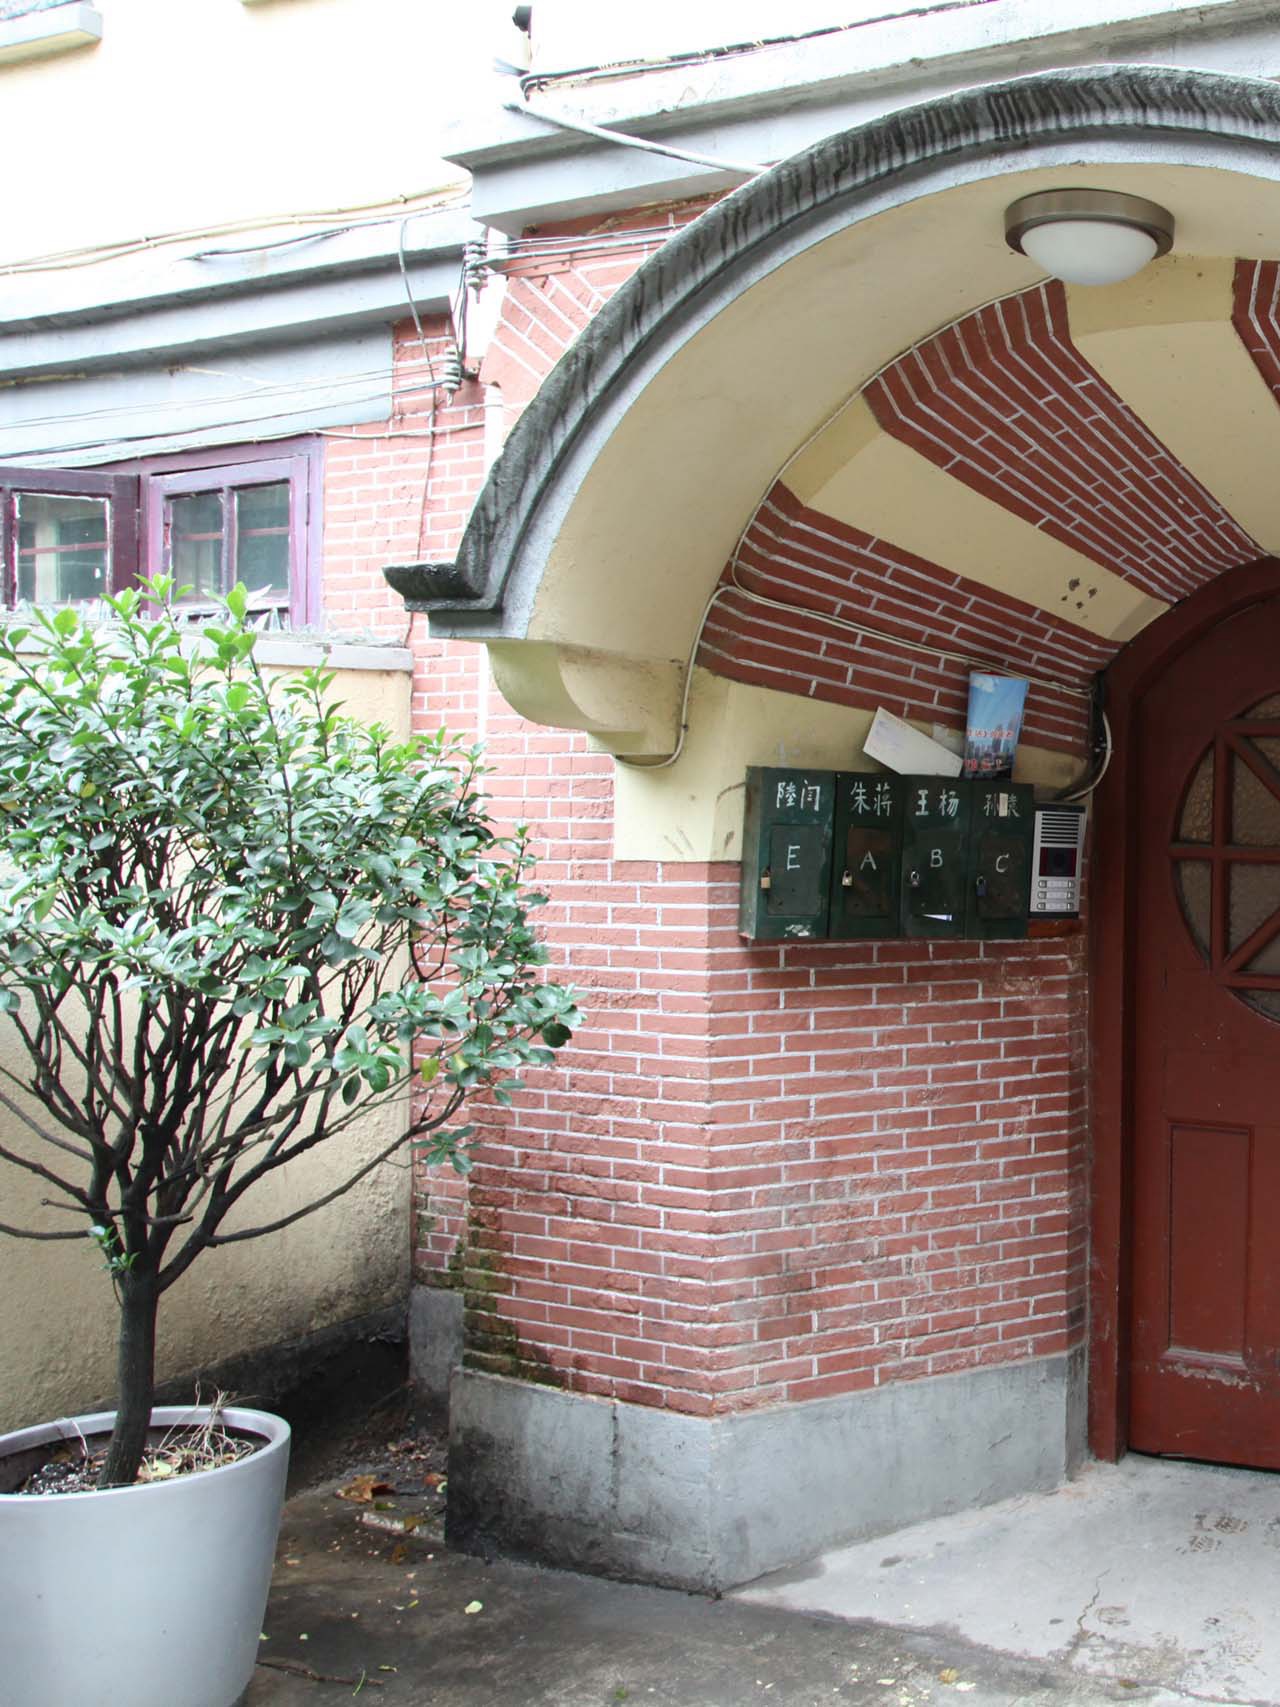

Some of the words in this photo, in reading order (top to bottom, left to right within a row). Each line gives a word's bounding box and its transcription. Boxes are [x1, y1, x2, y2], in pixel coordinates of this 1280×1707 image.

[786, 845, 801, 871] E
[859, 850, 877, 871] A
[930, 848, 943, 868] B
[995, 853, 1010, 873] C
